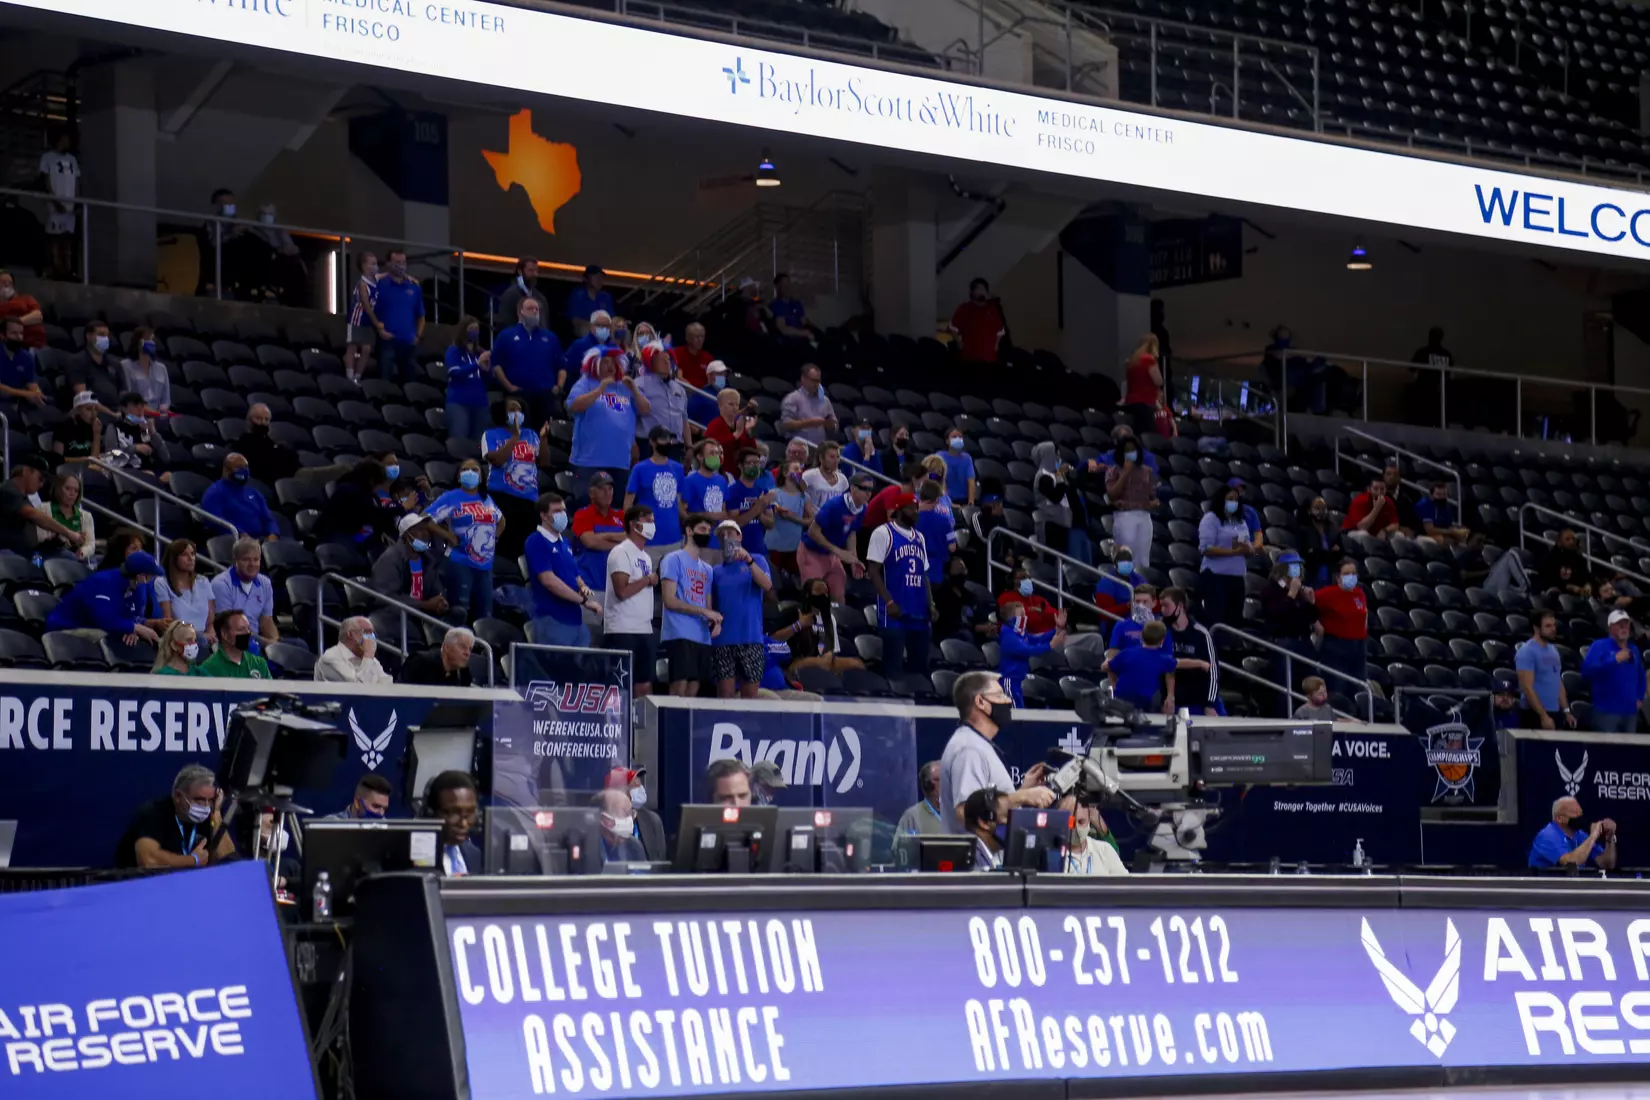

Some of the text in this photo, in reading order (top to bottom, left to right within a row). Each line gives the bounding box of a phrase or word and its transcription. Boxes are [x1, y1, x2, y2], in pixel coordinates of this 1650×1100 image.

[323, 13, 400, 41] FRISCO
[425, 4, 505, 33] CENTER
[1037, 110, 1173, 143] MEDICAL CENTER
[1038, 133, 1095, 154] FRISCO
[908, 558, 916, 573] 3
[905, 574, 922, 587] TECH
[1345, 740, 1391, 758] VOICE.
[1172, 773, 1179, 783] 2
[1593, 770, 1619, 785] AIR
[1274, 801, 1383, 813] Stronger Together #CUSAVoices
[453, 918, 823, 1005] COLLEGE TUITION
[968, 915, 1239, 988] 800-257-1212
[1483, 917, 1617, 981] AIR
[0, 985, 252, 1039] AIR FORCE
[5, 1022, 245, 1075] RESERVE
[964, 997, 1273, 1073] AFReserve.com
[523, 1005, 791, 1095] ASSISTANCE
